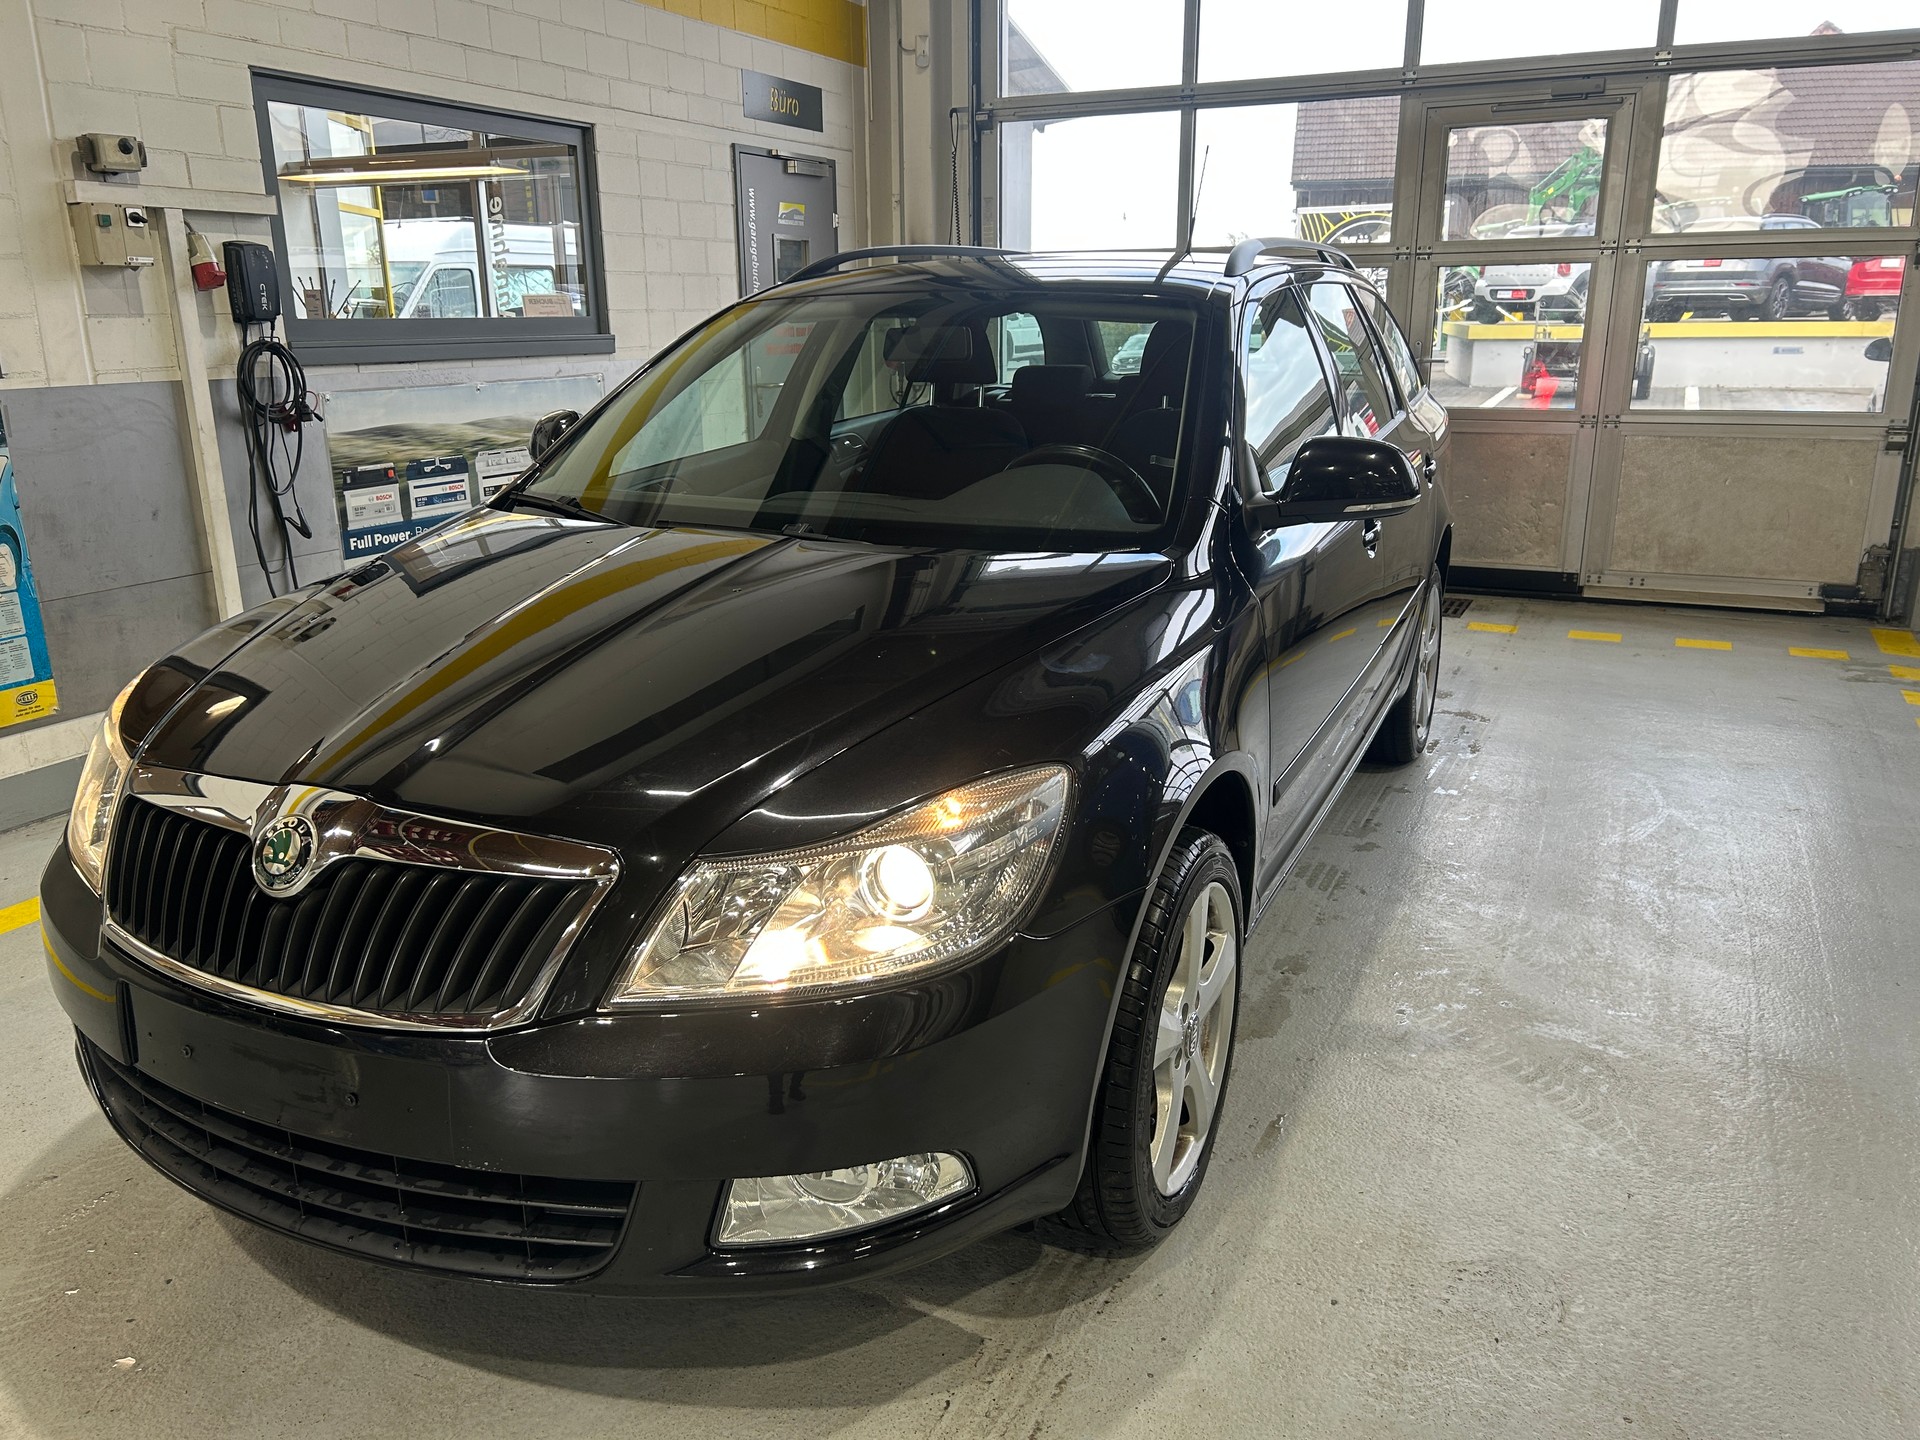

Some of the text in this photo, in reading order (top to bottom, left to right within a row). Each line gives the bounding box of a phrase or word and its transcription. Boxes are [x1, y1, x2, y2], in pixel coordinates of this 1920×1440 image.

[769, 87, 800, 118] Büro
[259, 283, 270, 311] CTEK
[448, 483, 465, 491] BOSCH
[375, 493, 393, 502] BOSCH
[349, 534, 373, 551] Full
